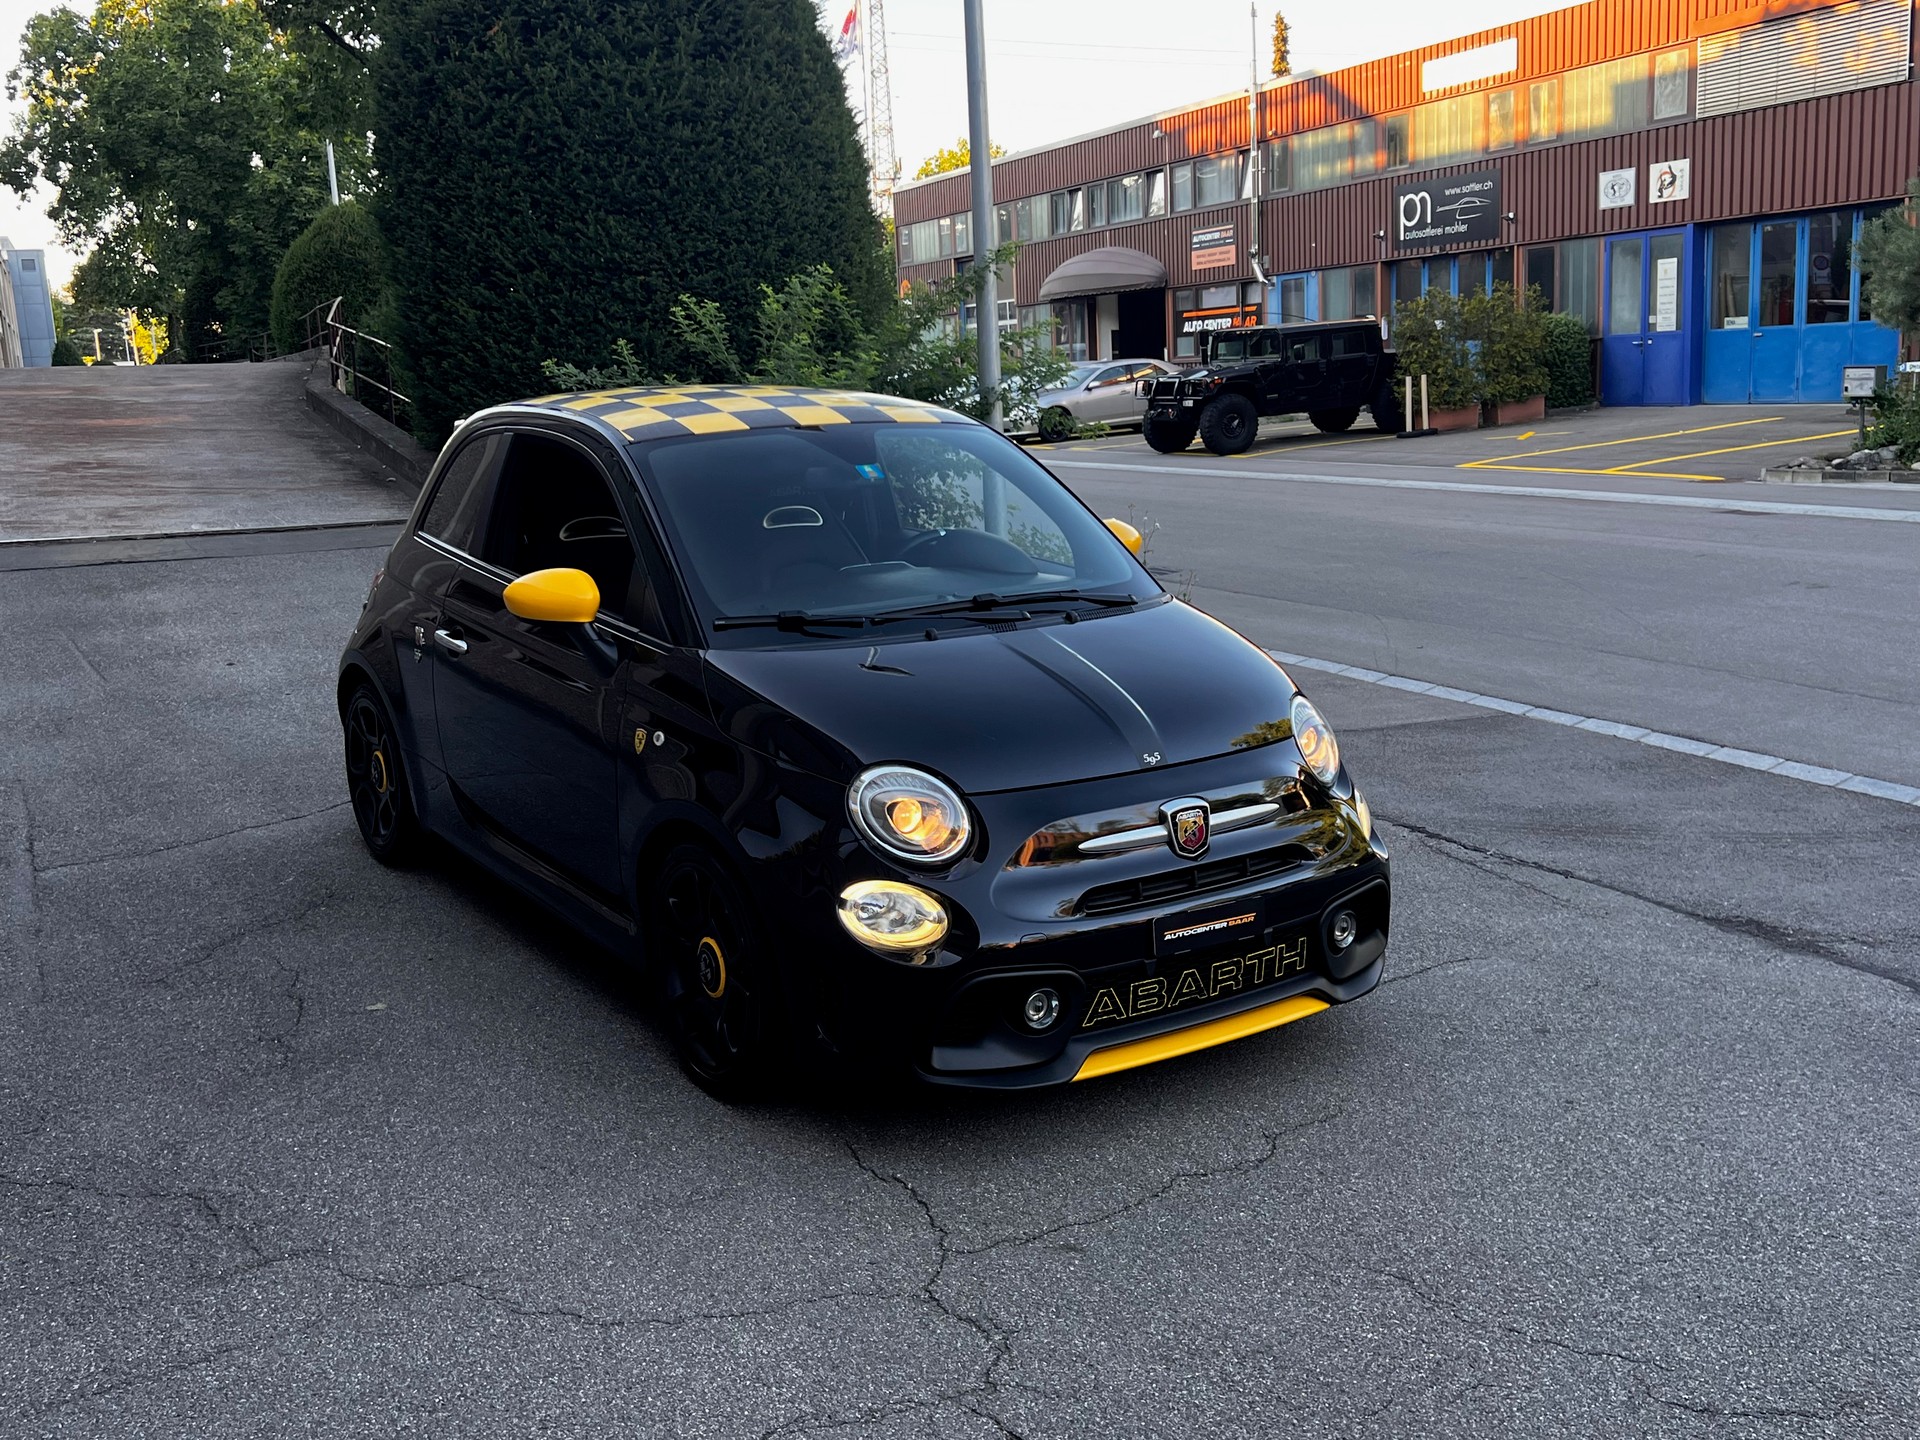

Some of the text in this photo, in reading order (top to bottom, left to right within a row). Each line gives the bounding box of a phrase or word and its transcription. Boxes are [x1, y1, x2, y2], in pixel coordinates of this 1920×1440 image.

[1444, 180, 1493, 196] www.sattler.ch
[1444, 220, 1469, 234] mohler
[1143, 752, 1161, 765] 595
[1163, 916, 1255, 941] AUTOCENTER BAAR
[1082, 937, 1307, 1027] ABARTH
